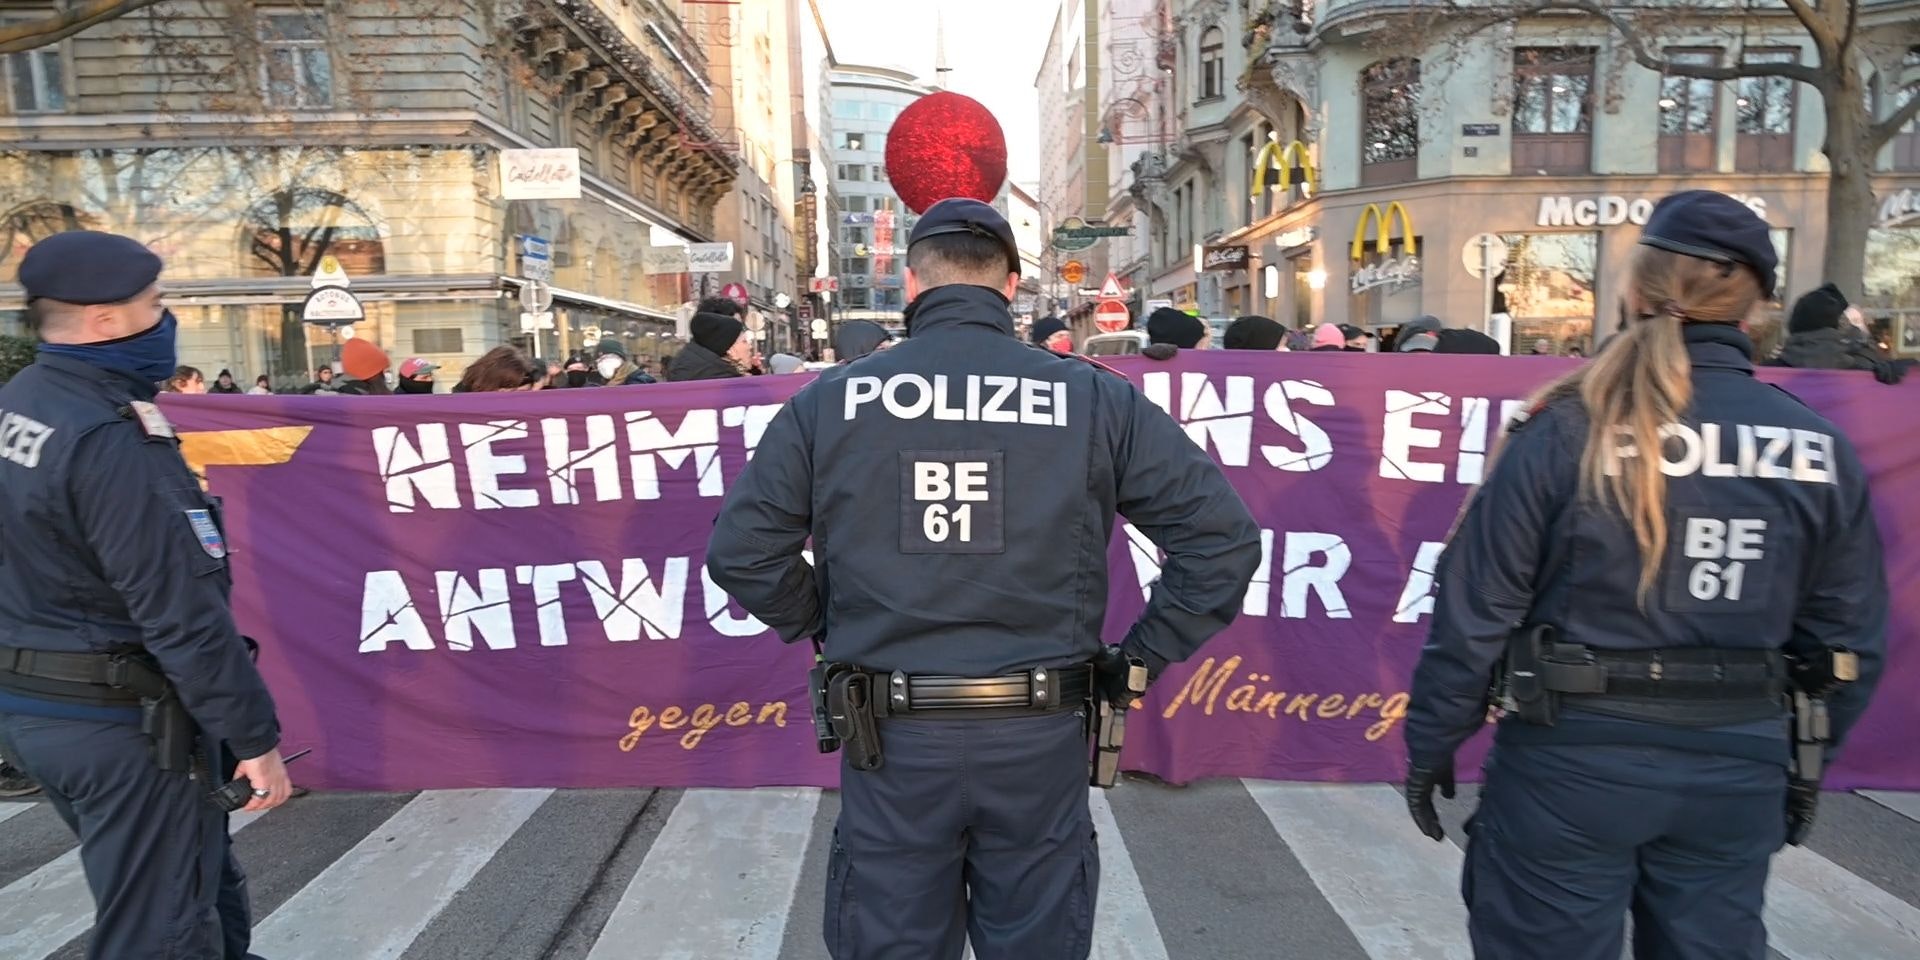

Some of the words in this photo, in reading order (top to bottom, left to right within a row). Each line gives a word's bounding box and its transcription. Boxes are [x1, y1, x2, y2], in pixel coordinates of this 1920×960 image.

[844, 373, 1068, 427] POLIZEI
[0, 408, 55, 468] IZEI
[1379, 388, 1525, 484] EI
[1601, 422, 1838, 485] POLIZEI
[914, 461, 990, 502] BE
[923, 503, 972, 542] 61
[1684, 517, 1768, 559] BE
[358, 550, 815, 653] ANTWO
[1688, 561, 1746, 601] 61
[618, 700, 788, 753] gegen
[1162, 654, 1410, 742] Männerg
